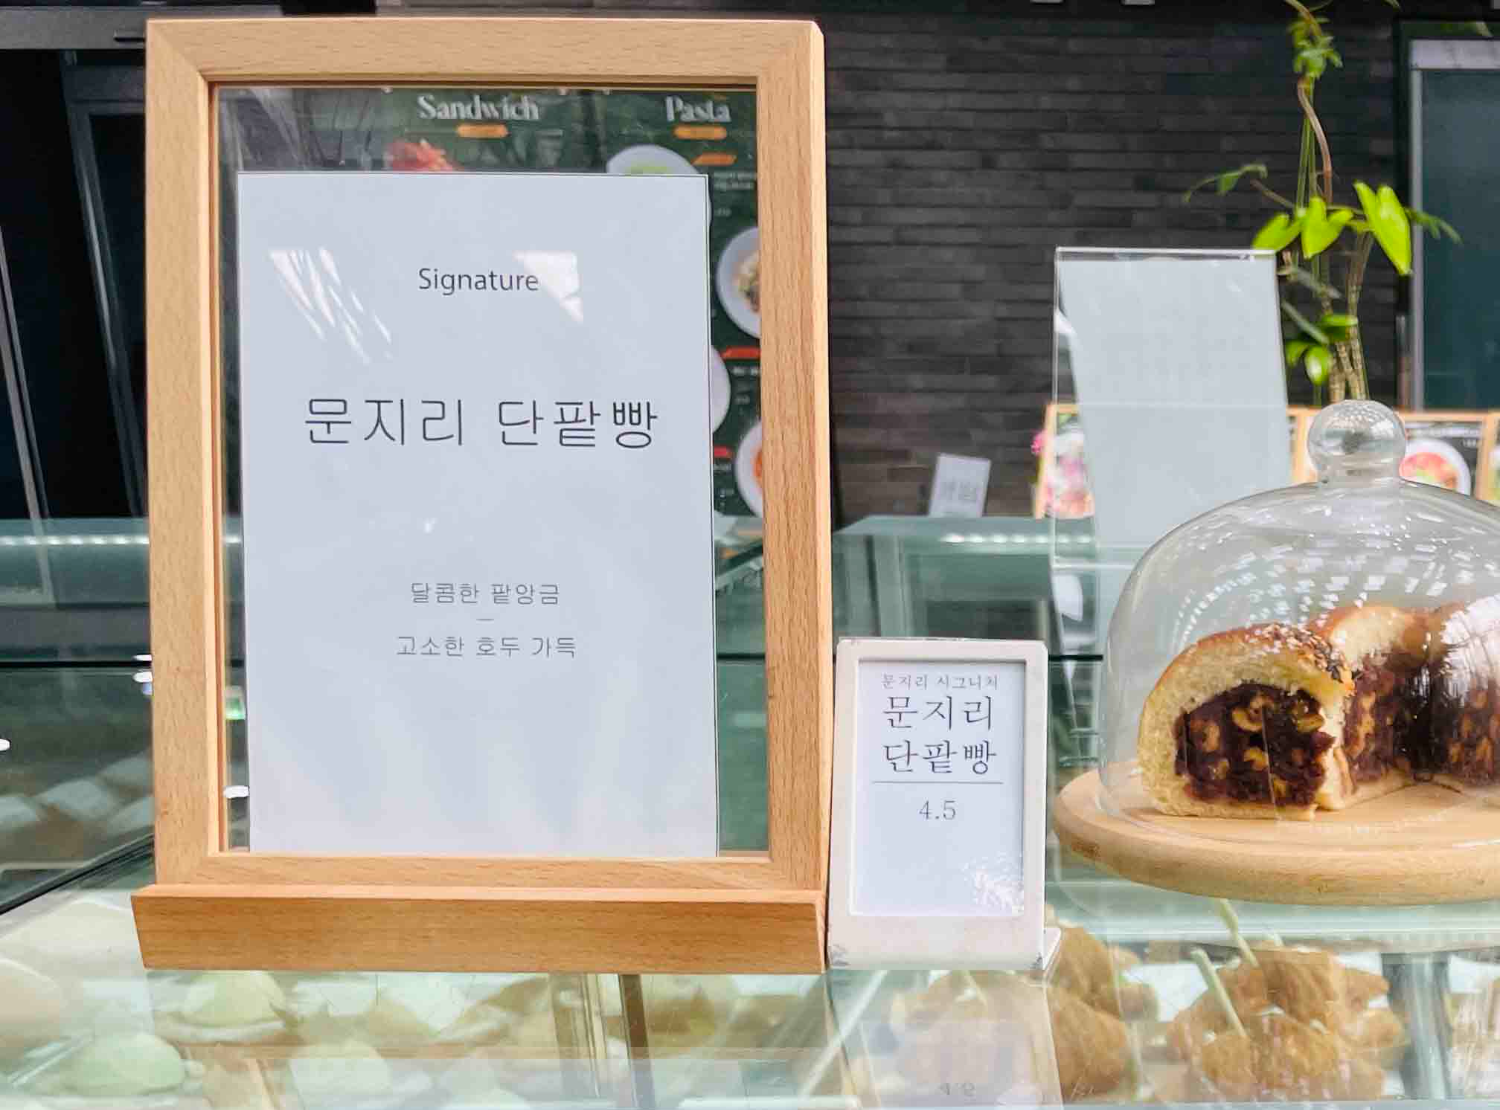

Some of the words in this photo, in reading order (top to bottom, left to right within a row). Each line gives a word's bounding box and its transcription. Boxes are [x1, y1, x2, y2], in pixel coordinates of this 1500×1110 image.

[417, 93, 540, 121] Sandwich
[664, 95, 732, 123] Pasta
[418, 266, 540, 296] Signature
[304, 398, 463, 446] 문지리
[498, 399, 659, 449] 단팥빵
[410, 582, 480, 604] 달콤한
[490, 583, 560, 606] 팥앙금
[395, 635, 466, 658] 고소한
[475, 635, 521, 658] 호두
[531, 636, 577, 659] 가득
[881, 673, 929, 690] 문지리
[882, 695, 992, 731] 문지리
[882, 739, 998, 775] 단팥빵
[918, 799, 957, 821] 4.5
